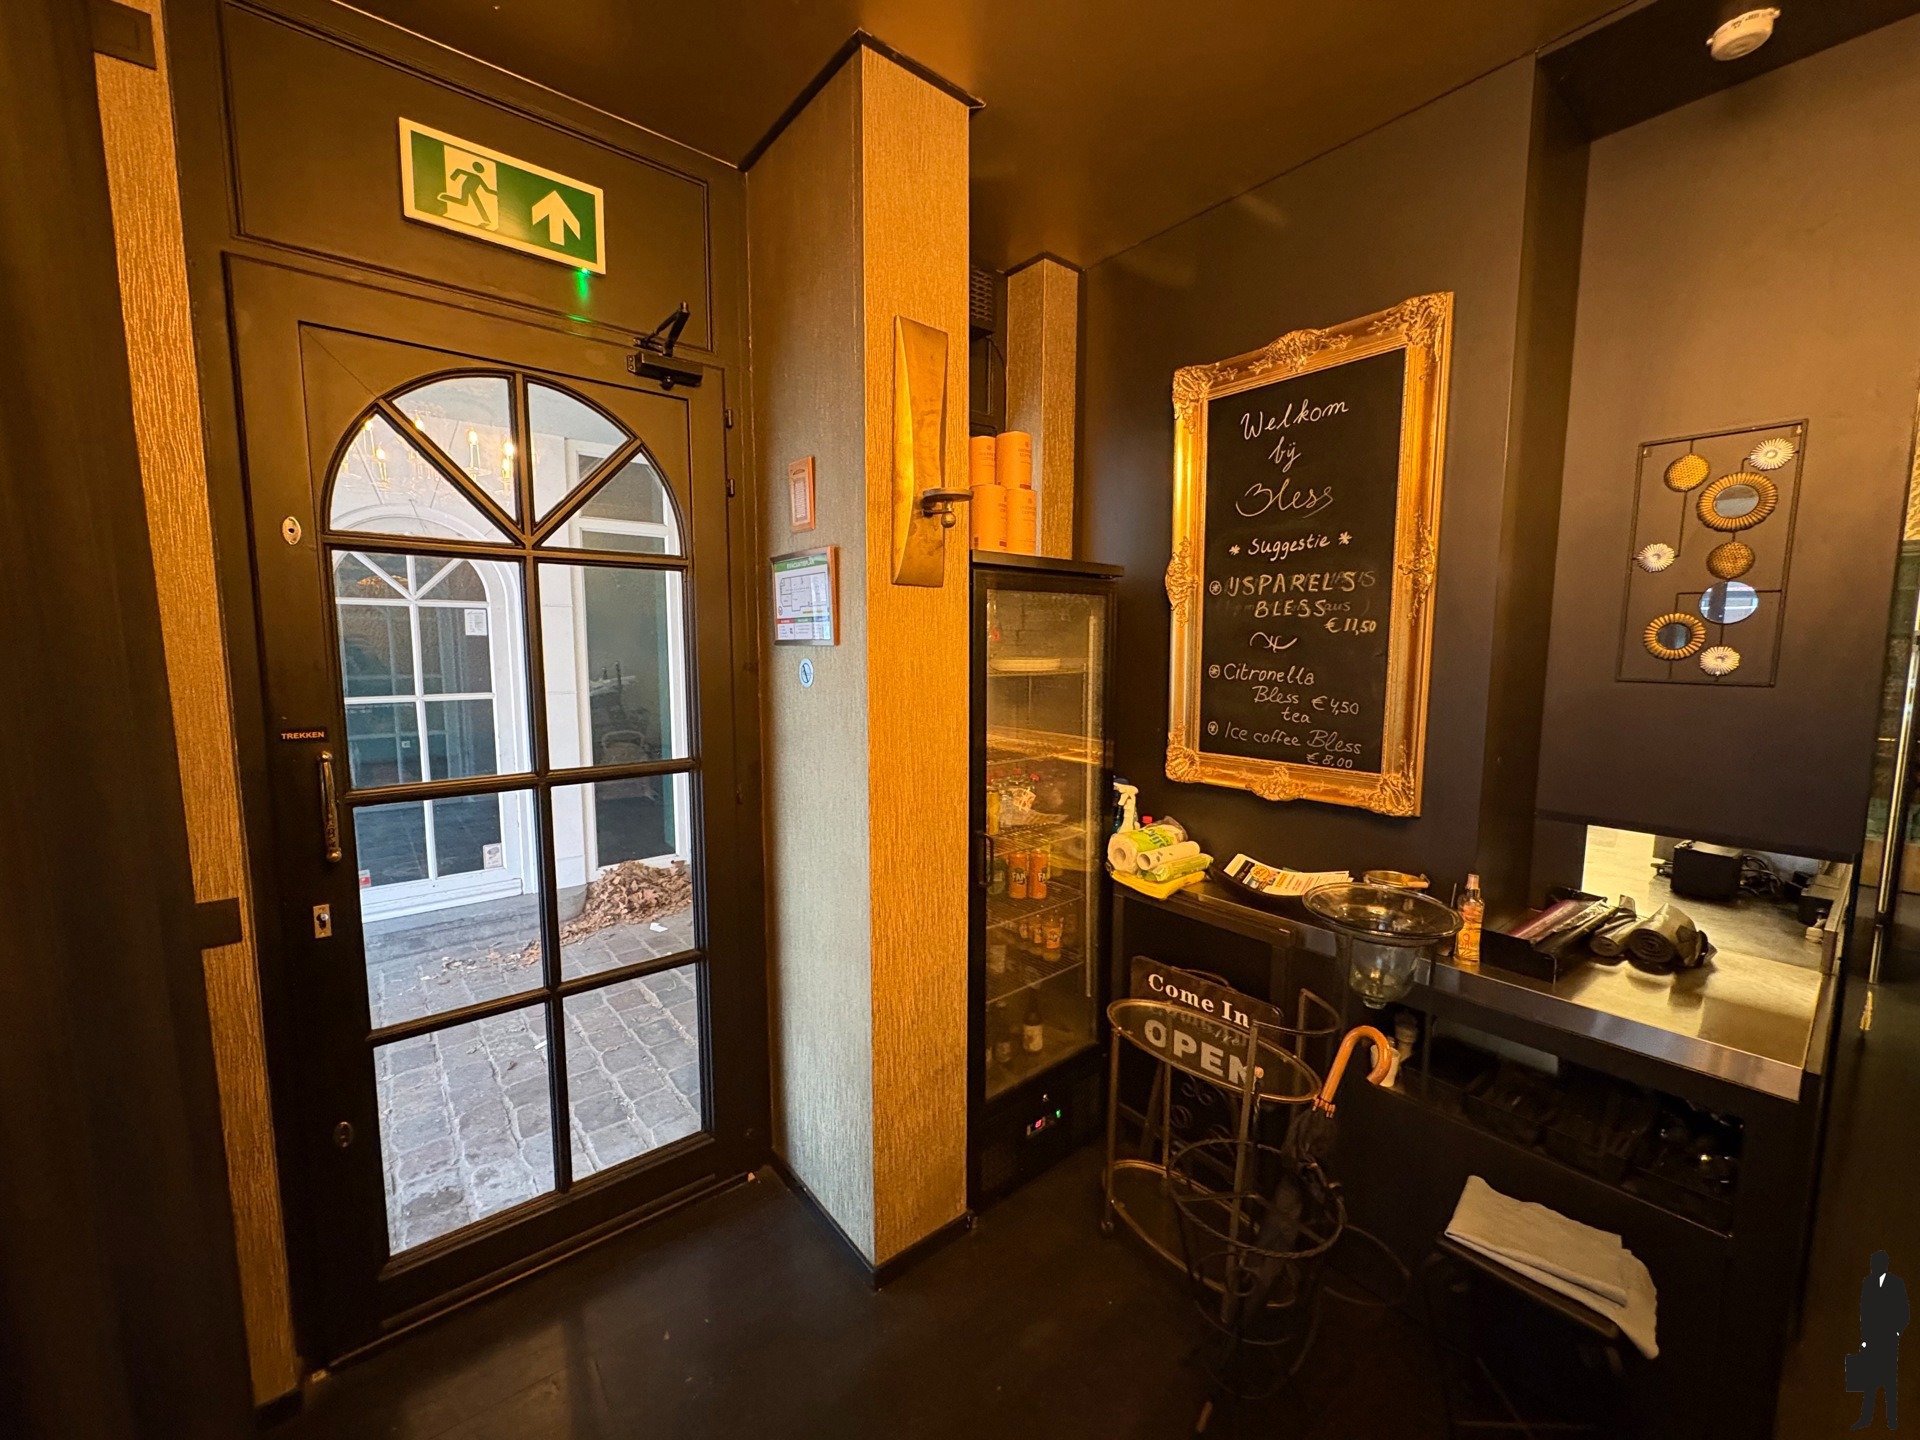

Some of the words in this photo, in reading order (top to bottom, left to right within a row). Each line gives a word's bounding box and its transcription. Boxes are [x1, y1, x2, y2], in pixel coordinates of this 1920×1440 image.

[1240, 399, 1349, 440] Welkom
[1268, 436, 1302, 474] bij
[1235, 477, 1335, 519] Bless
[1247, 535, 1331, 562] Suggestie
[1254, 599, 1327, 618] BLESS
[1223, 663, 1315, 686] Citronella
[1251, 685, 1300, 704] Bless
[1281, 706, 1312, 724] tea
[280, 731, 325, 740] TREKKEN
[1224, 721, 1248, 742] Ice
[1253, 729, 1301, 747] coffee
[1306, 729, 1362, 755] Bless
[1148, 973, 1214, 1012] Come
[1221, 1000, 1249, 1028] In
[1144, 1019, 1250, 1085] OPEN
